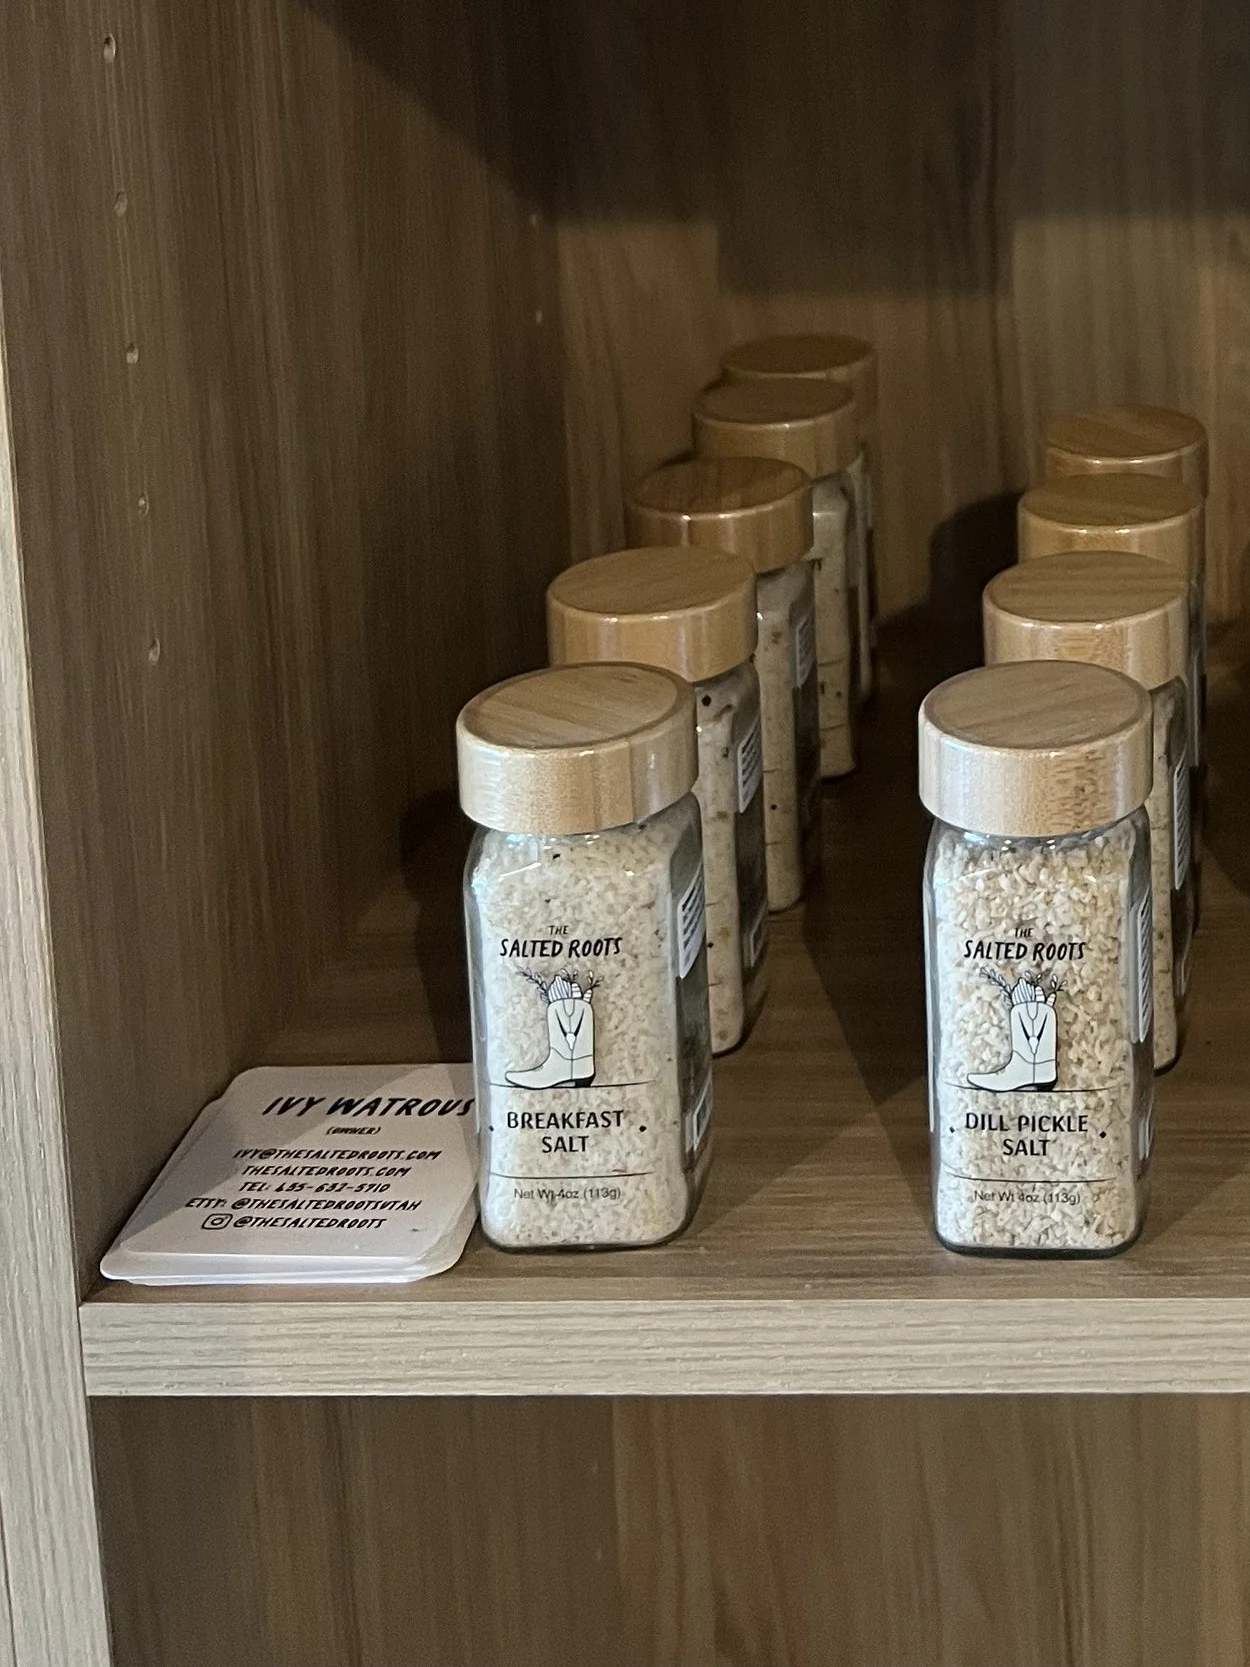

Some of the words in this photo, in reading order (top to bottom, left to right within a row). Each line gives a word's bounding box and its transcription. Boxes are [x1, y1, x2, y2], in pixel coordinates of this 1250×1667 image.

[548, 924, 570, 936] THE
[1013, 926, 1034, 939] THE
[499, 938, 564, 958] SALTED
[567, 936, 623, 958] ROOTS
[963, 939, 1029, 961] SALTED
[1032, 940, 1087, 961] ROOTS
[262, 1096, 326, 1117] IVY
[326, 1096, 475, 1117] WATROUS
[506, 1109, 625, 1130] BREAKFAST
[965, 1111, 1010, 1133] DILL
[1017, 1114, 1089, 1134] PICKLE
[541, 1135, 590, 1154] SALT
[1002, 1138, 1050, 1157] SALT
[232, 1148, 442, 1161] IVY@THESALTEDROOTS.COM
[240, 1165, 412, 1177] THESALTEDROOTS.COM
[513, 1187, 535, 1200] Net
[556, 1188, 580, 1200] 4oz
[583, 1187, 622, 1202] (113g)
[973, 1189, 996, 1202] Net
[998, 1190, 1016, 1203] Wt
[1043, 1191, 1082, 1206] (113g)
[232, 1215, 388, 1229] @THESALTEDROOTS
